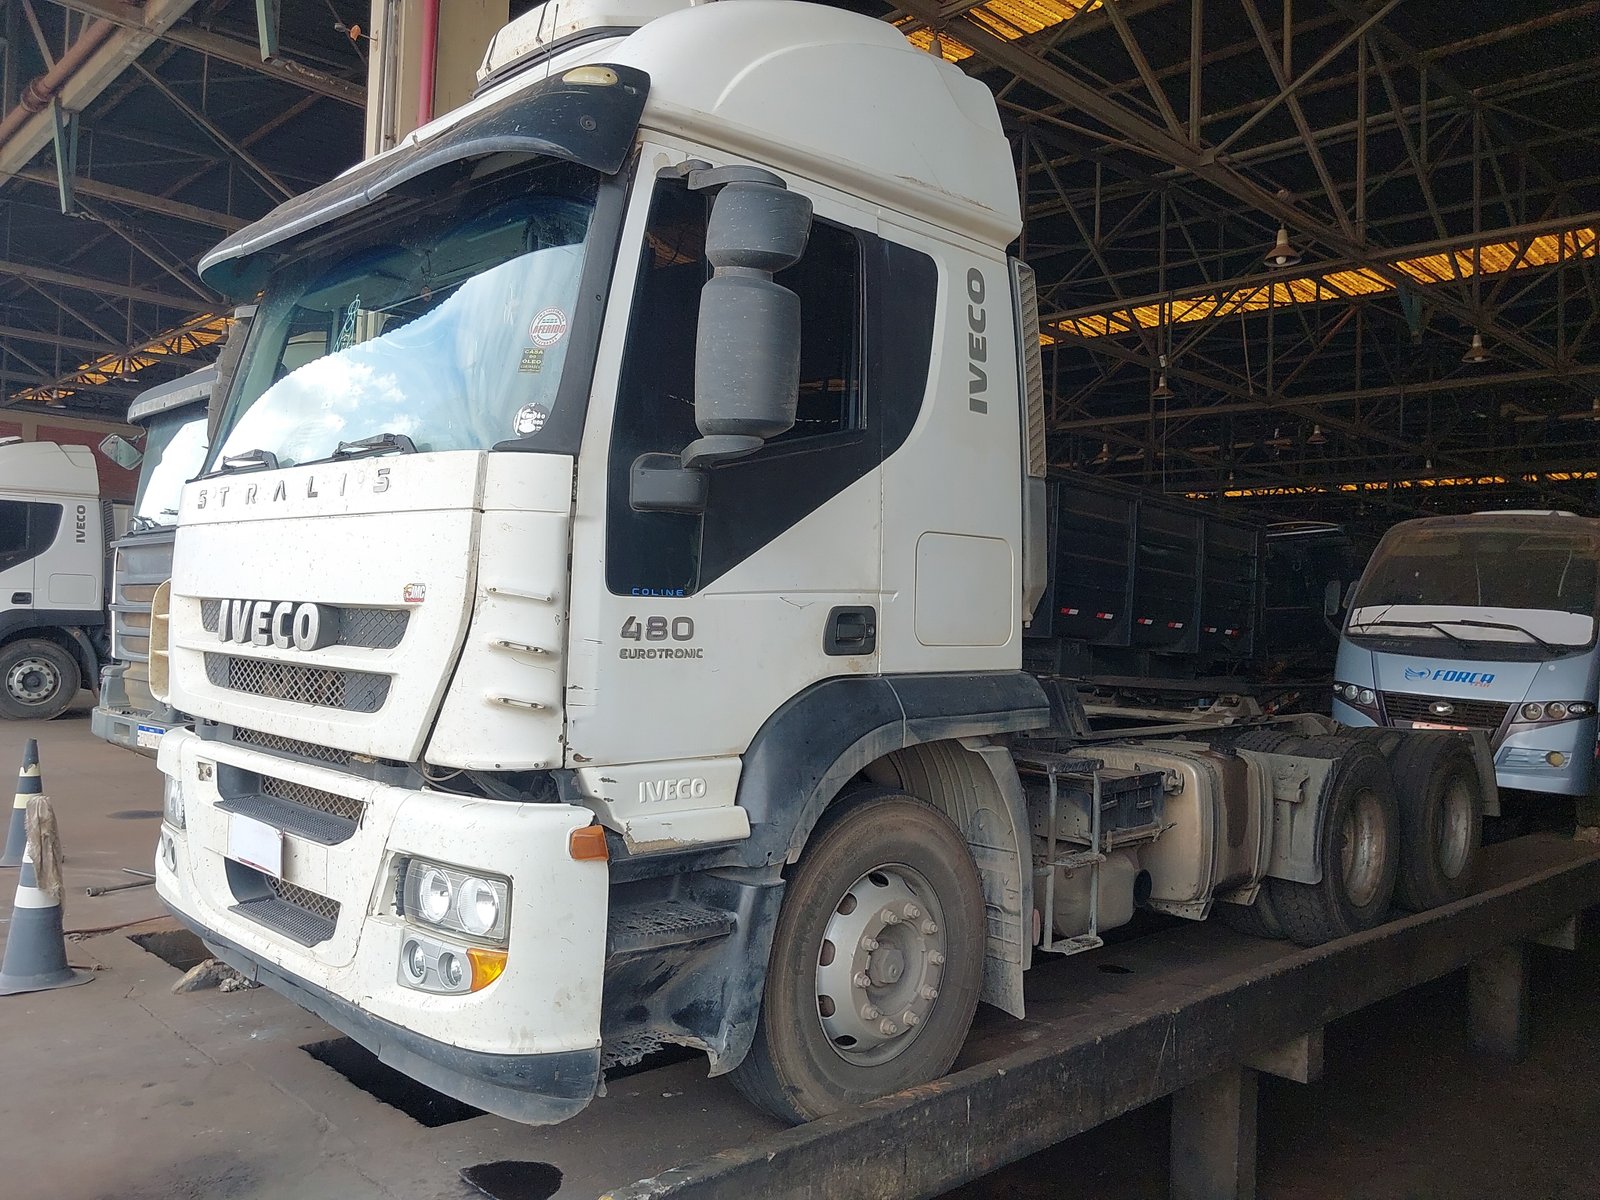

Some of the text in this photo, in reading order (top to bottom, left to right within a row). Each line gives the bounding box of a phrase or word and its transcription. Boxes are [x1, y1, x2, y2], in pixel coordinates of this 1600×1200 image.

[532, 324, 566, 334] AFERIDO
[967, 267, 987, 415] IVECO
[197, 467, 391, 509] STRALIS
[76, 504, 86, 544] IVECO
[631, 587, 684, 597] COLINE
[217, 599, 321, 651] IVECO
[620, 615, 695, 641] 480
[619, 648, 704, 660] EUROTRONIC
[638, 777, 707, 804] IVECO
